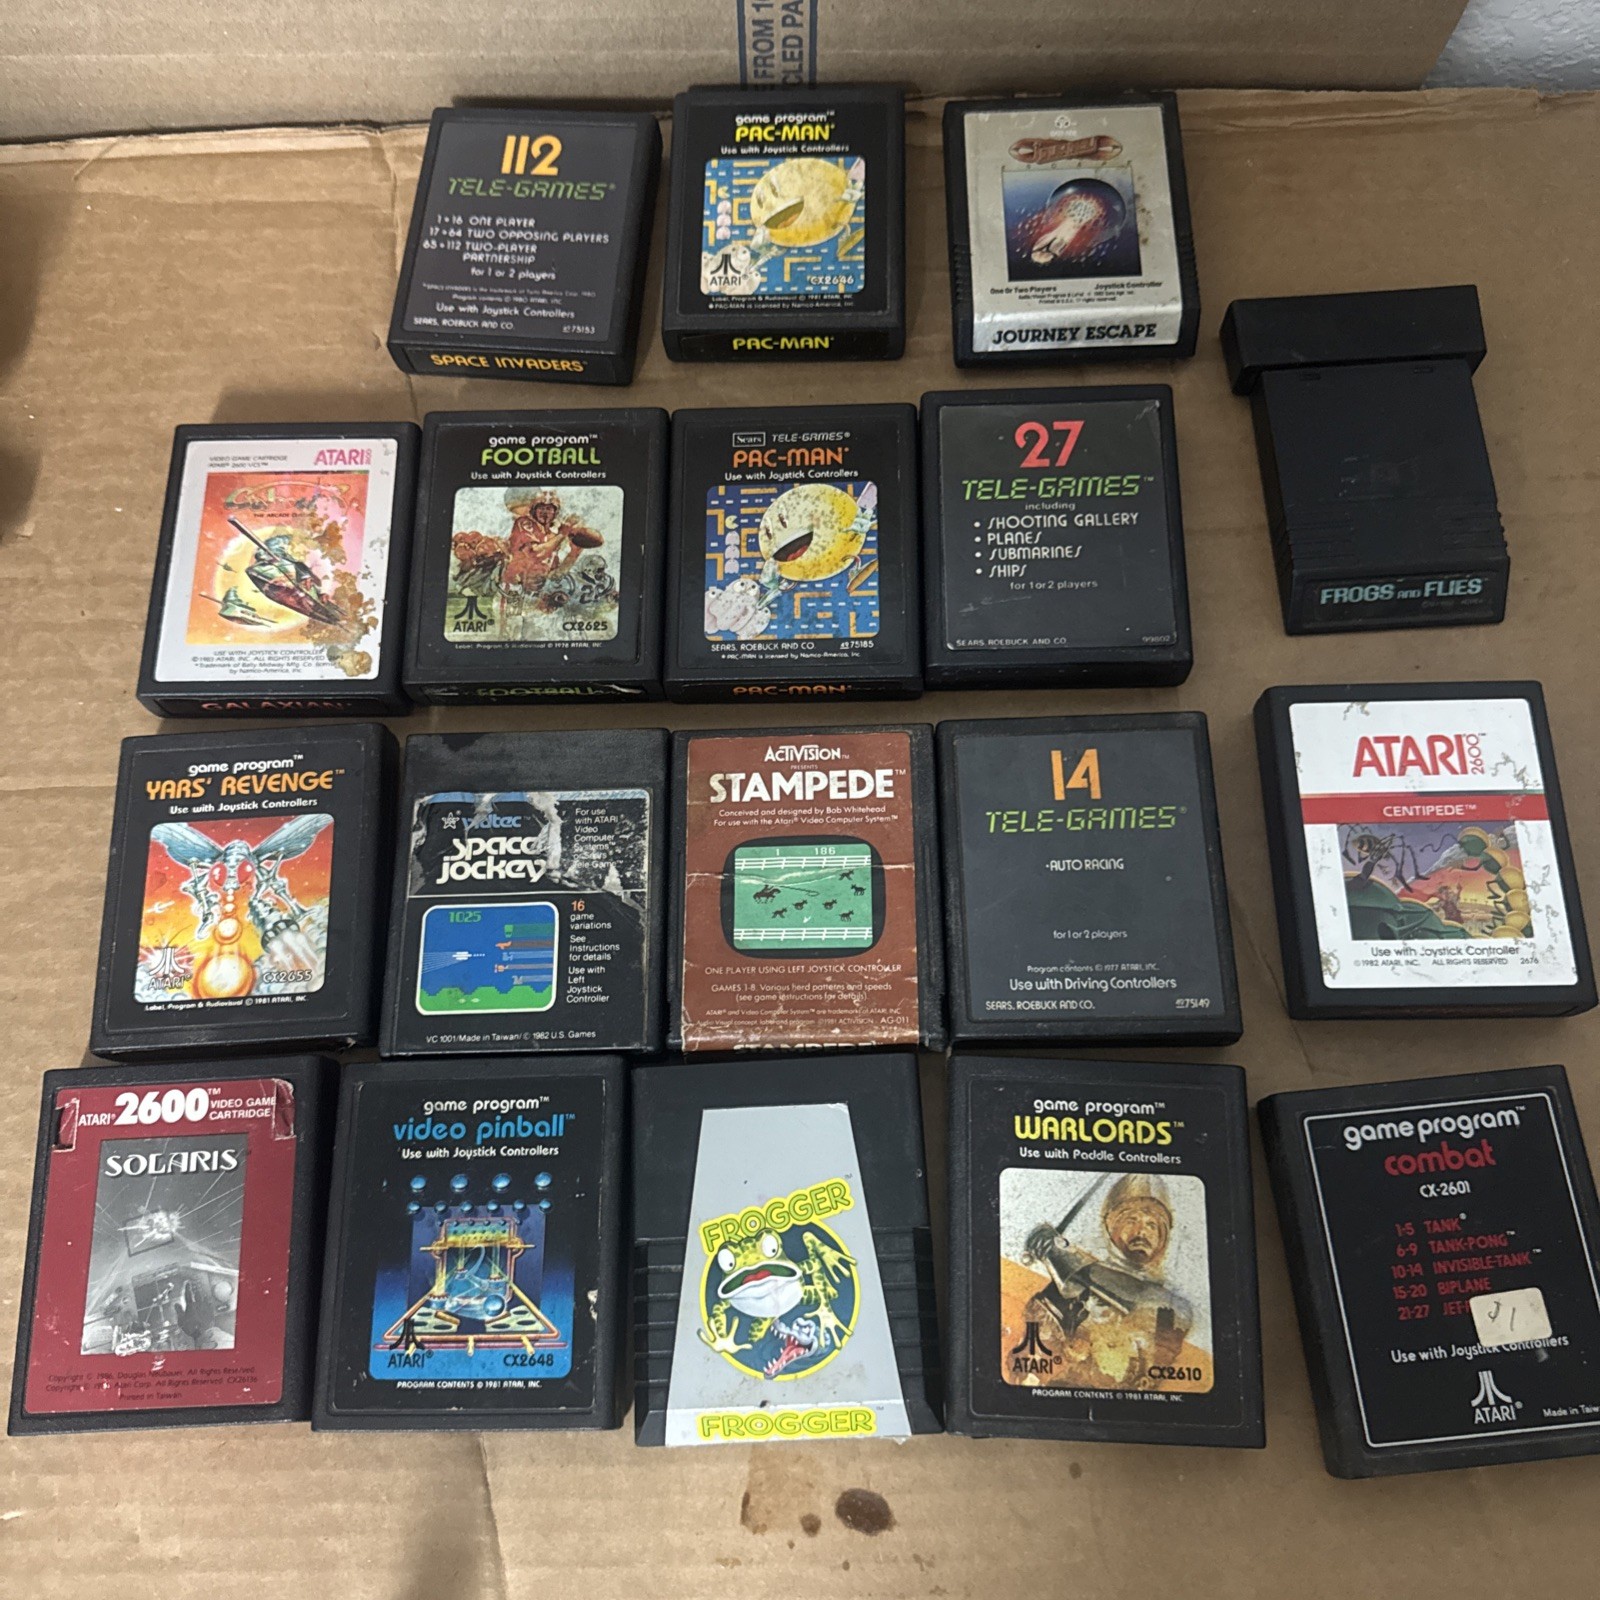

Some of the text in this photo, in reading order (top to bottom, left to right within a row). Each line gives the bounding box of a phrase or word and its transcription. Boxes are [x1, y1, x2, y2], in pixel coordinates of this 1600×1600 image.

[752, 19, 774, 78] FROM
[735, 114, 770, 125] game
[501, 135, 562, 176] 112
[470, 217, 535, 228] ONE PLAYER
[467, 229, 610, 243] TWO OPPOSING PLAYERS
[466, 243, 537, 254] TWO-PLAYER
[463, 253, 535, 264] PARTNERSHIP
[810, 275, 854, 285] CX2646
[1094, 281, 1162, 291] Joystick Controller
[992, 324, 1157, 344] JOURNEY ESCAPE
[430, 354, 584, 372] SPACE INVADERS
[736, 435, 762, 444] Sears
[1015, 420, 1085, 468] 27
[313, 449, 365, 466] ATARI
[481, 448, 601, 465] FOOTBALL
[725, 470, 858, 481] Use with Joystick Controllers
[1025, 502, 1075, 511] including
[987, 513, 1139, 529] SHOOTING GALLERY
[987, 531, 1042, 544] PLANES
[989, 546, 1082, 560] SUBMARINES
[989, 564, 1027, 577] SHIPS
[1320, 578, 1482, 605] FROGS AND FLIES
[562, 621, 607, 632] CX2625
[741, 643, 779, 651] ROEBUCK
[781, 642, 799, 650] AND
[1353, 733, 1485, 778] ATARI 2600
[188, 762, 229, 777] game
[1051, 748, 1102, 801] 14
[169, 798, 317, 815] Use with Joystick Controllers
[575, 808, 588, 816] For
[719, 805, 886, 817] Conceived and designed by Bob Whitehead
[815, 847, 836, 856] 186
[1085, 858, 1124, 870] RACING
[435, 858, 547, 885] jockey
[571, 900, 585, 911] 16
[448, 911, 482, 923] 1025
[570, 913, 594, 921] game
[570, 921, 611, 930] variations
[570, 935, 586, 943] See
[569, 943, 620, 951] Instructions
[1371, 946, 1391, 956] Use
[1395, 945, 1416, 956] with
[1466, 944, 1519, 956] Controller
[569, 952, 611, 961] for details
[1521, 957, 1539, 965] 2676
[587, 966, 605, 974] with
[705, 963, 902, 975] ONE PLAYER USING LEFT JOYSTICK CONTROLLER
[263, 970, 313, 982] CX2655
[568, 976, 585, 984] Left
[567, 985, 602, 994] Joystick
[1009, 977, 1177, 992] Use with Driving Controllers
[566, 994, 609, 1003] Controller
[1017, 999, 1057, 1010] ROEBUCK
[1060, 999, 1077, 1009] AND
[880, 1015, 909, 1024] AG-011
[211, 1096, 276, 1108] VIDEO GAME
[1034, 1099, 1078, 1113] game
[210, 1108, 271, 1120] CARTRIDGE
[393, 1118, 466, 1142] video
[1344, 1120, 1414, 1151] game
[1020, 1148, 1181, 1164] Use with Paddle Controllers
[1384, 1139, 1496, 1176] combat
[104, 1149, 238, 1177] SOLARIS
[1420, 1180, 1471, 1199] CX-2601
[702, 1181, 850, 1253] FROGGER
[1396, 1223, 1415, 1236] 1-5
[1396, 1244, 1418, 1257] 6-9
[1391, 1264, 1424, 1279] 10-14
[1393, 1277, 1492, 1299] 15-20 BIPLANE
[1398, 1305, 1430, 1320] 21-27
[503, 1353, 554, 1367] CX2648
[1148, 1366, 1201, 1381] CX2610
[1543, 1406, 1578, 1418] Made in
[702, 1411, 873, 1437] FROGGER
